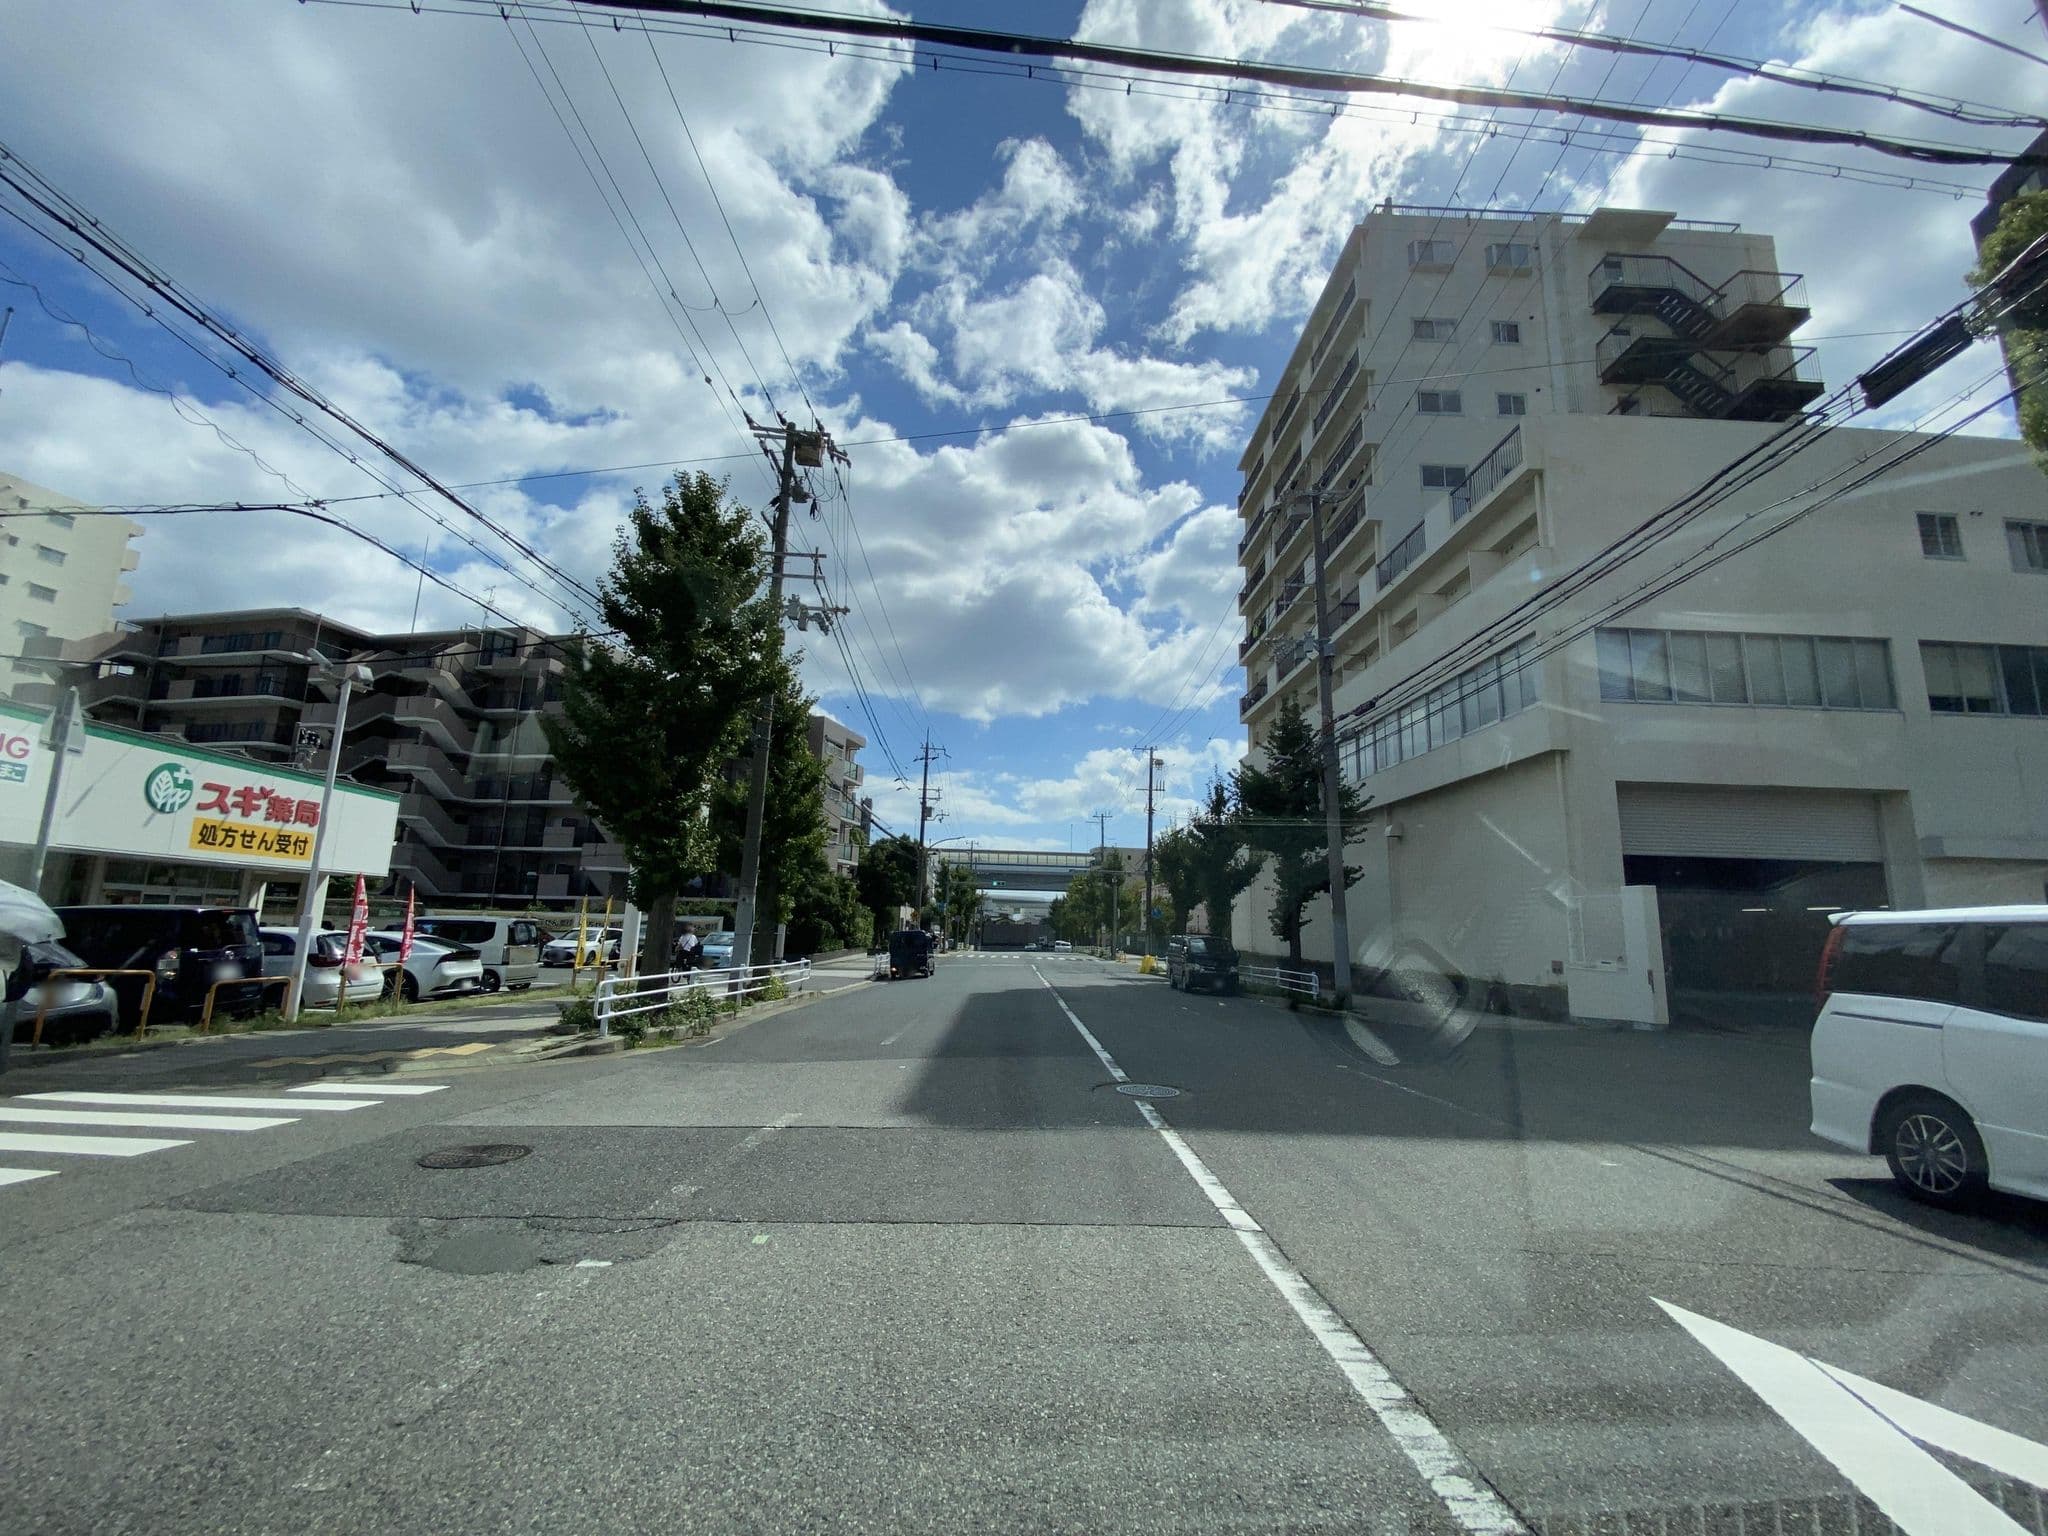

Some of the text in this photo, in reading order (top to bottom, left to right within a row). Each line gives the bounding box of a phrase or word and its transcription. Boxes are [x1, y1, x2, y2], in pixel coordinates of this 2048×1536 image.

[197, 782, 321, 827] スギ薬局
[198, 823, 309, 855] 処方せん受付
